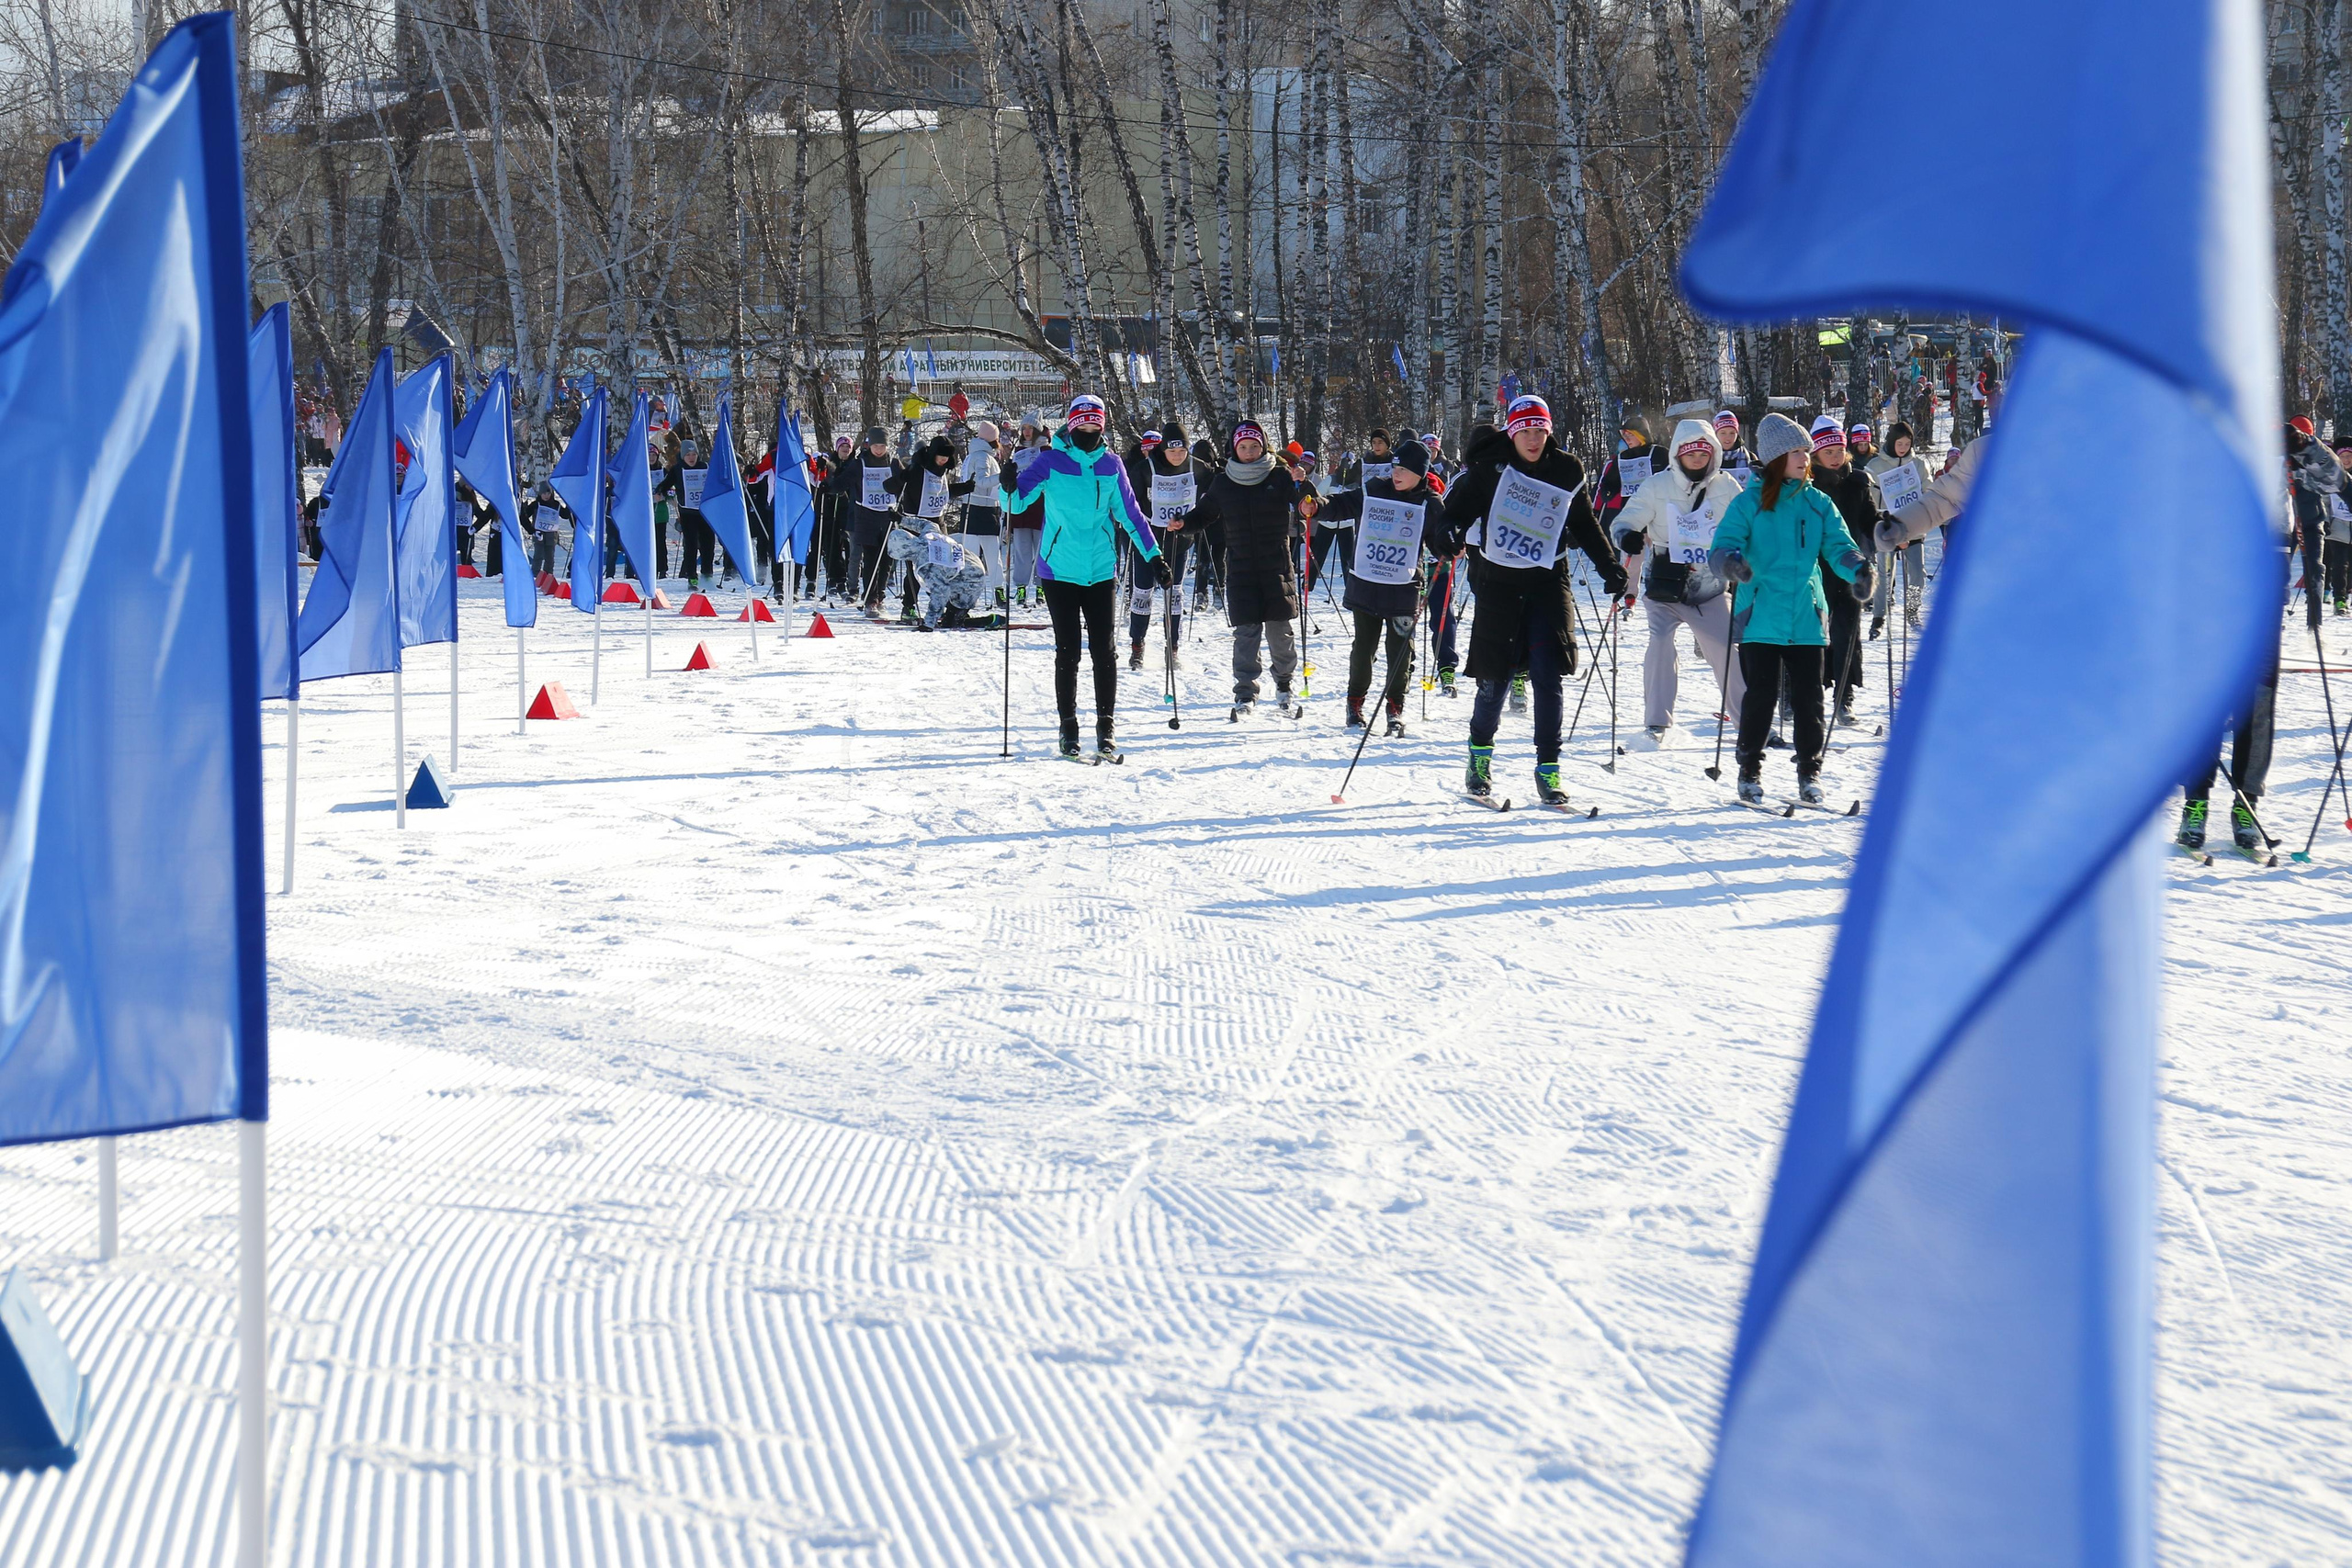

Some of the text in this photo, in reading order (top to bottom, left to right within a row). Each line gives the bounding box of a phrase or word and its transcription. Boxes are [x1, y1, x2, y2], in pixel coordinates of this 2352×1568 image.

[960, 359, 1035, 372] УНИВЕРСИТЕТ
[1509, 482, 1542, 500] ЛЫЖНЯ
[868, 493, 891, 505] 3613
[928, 495, 946, 508] 3851
[1506, 489, 1538, 508] РОССИИ
[1894, 491, 1918, 510] 4069
[1368, 506, 1395, 516] ЛЫЖНЯ
[1503, 498, 1533, 517] 2023
[1368, 513, 1394, 523] РОССИИ
[1368, 521, 1393, 531] 2023
[1494, 525, 1544, 562] 3756
[1366, 543, 1408, 566] 3622
[1369, 562, 1398, 573] ТЮМЕНСКАЯ
[1372, 570, 1394, 578] ОБЛАСТЬ
